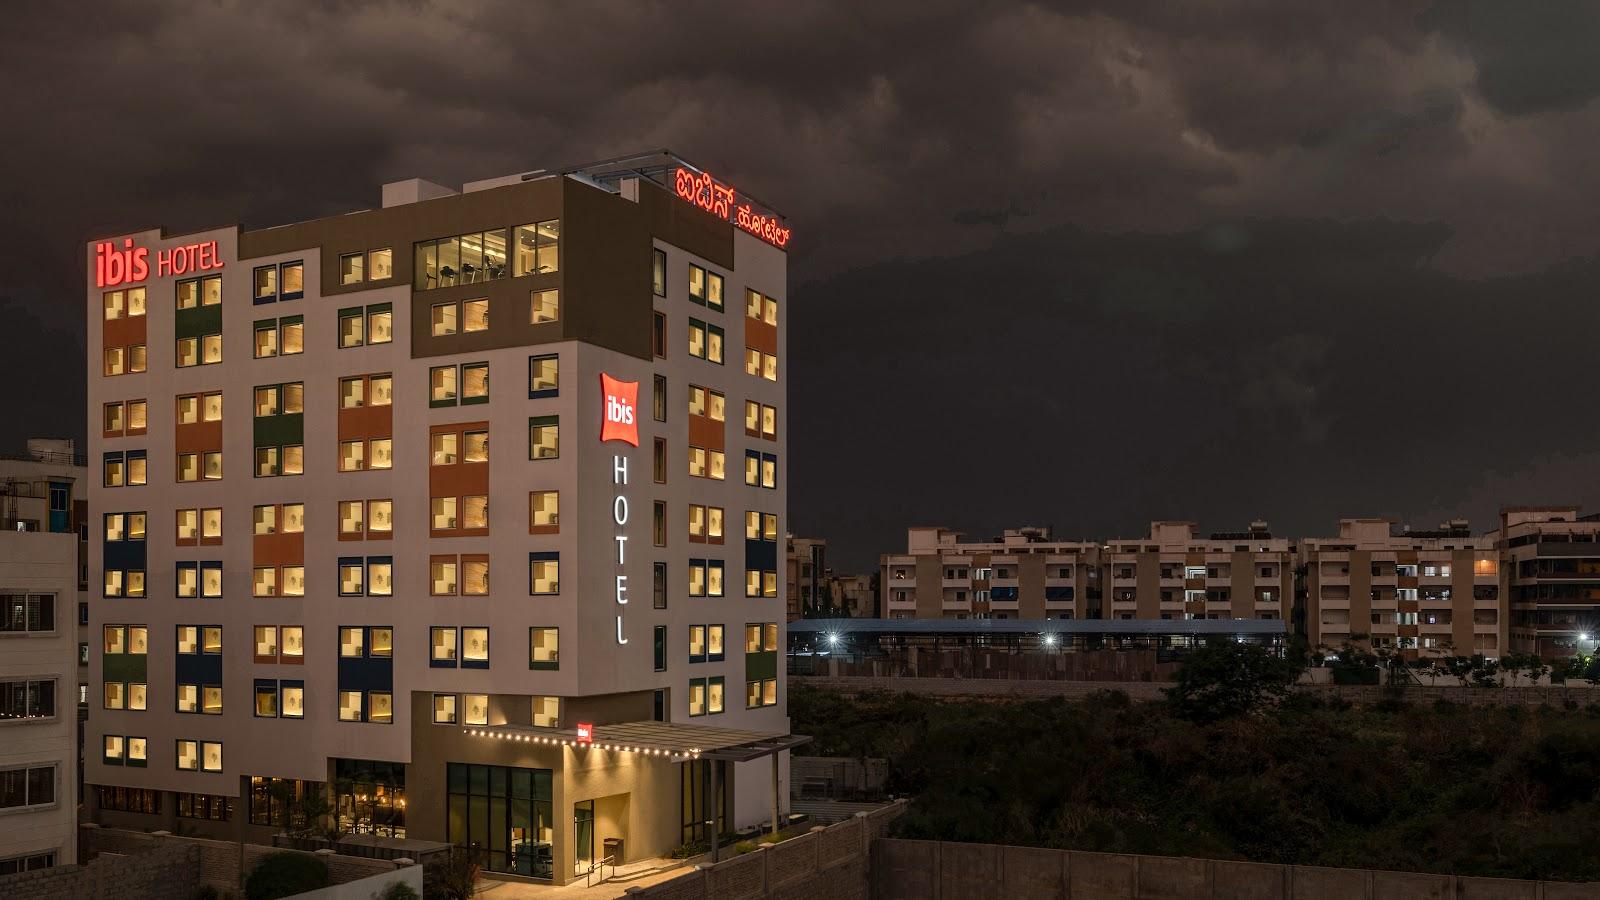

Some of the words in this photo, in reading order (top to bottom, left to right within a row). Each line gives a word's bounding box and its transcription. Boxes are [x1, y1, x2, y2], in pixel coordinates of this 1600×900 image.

[96, 238, 150, 288] ibis
[158, 240, 225, 277] HOTEL
[607, 395, 634, 425] ibis
[613, 455, 629, 645] HOTEL
